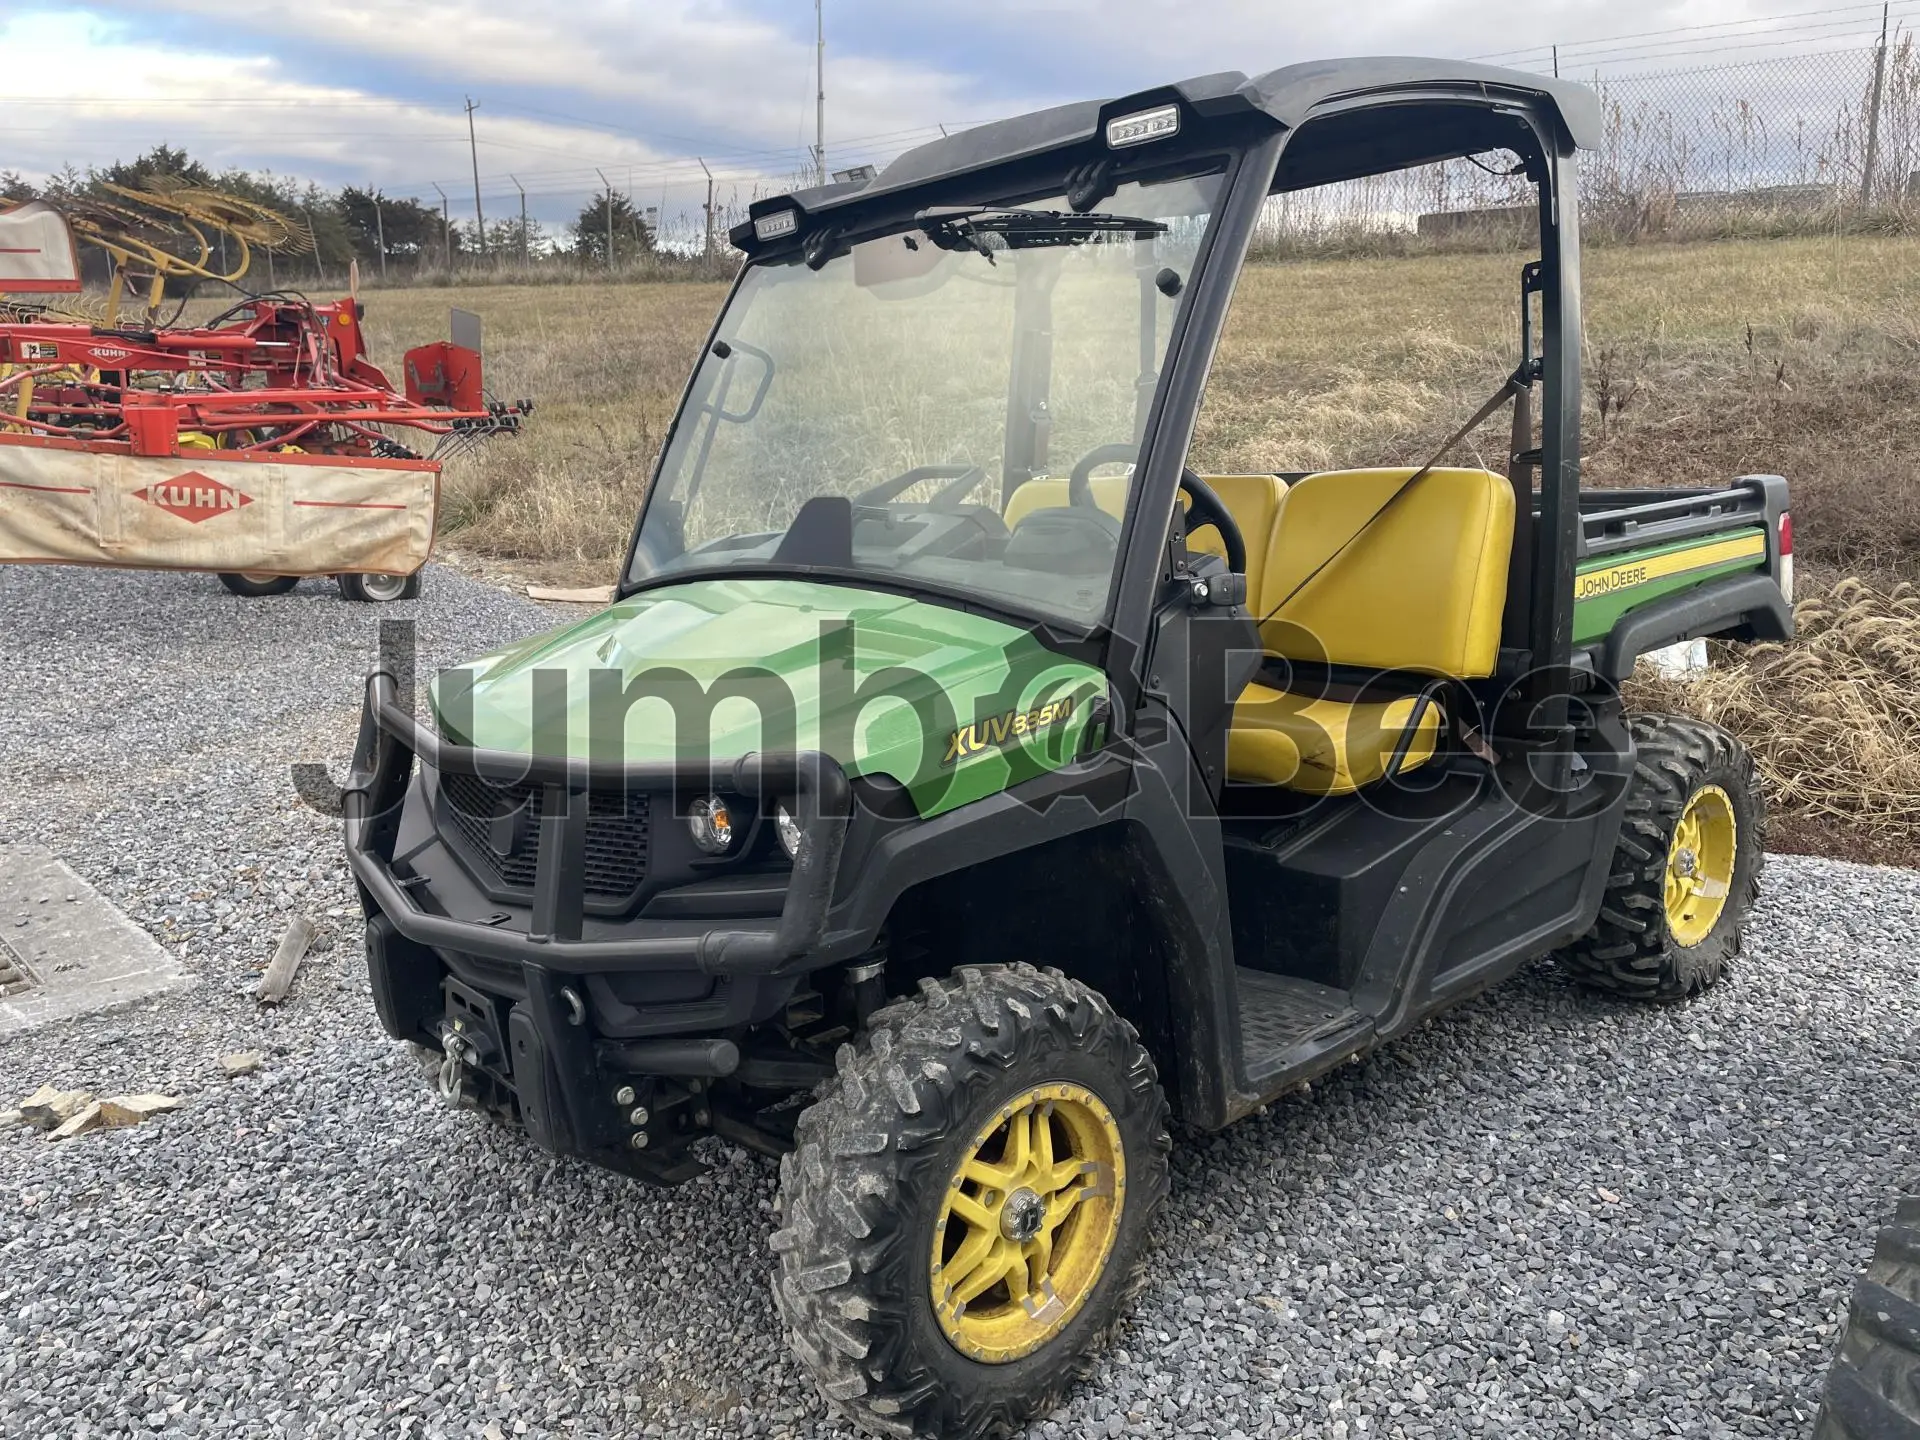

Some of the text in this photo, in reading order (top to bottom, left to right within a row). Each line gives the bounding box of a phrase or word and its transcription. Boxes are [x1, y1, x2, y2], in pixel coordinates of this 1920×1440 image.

[94, 348, 126, 357] KUHN
[146, 484, 240, 509] KUHN
[1579, 567, 1647, 597] JOHN DEERE
